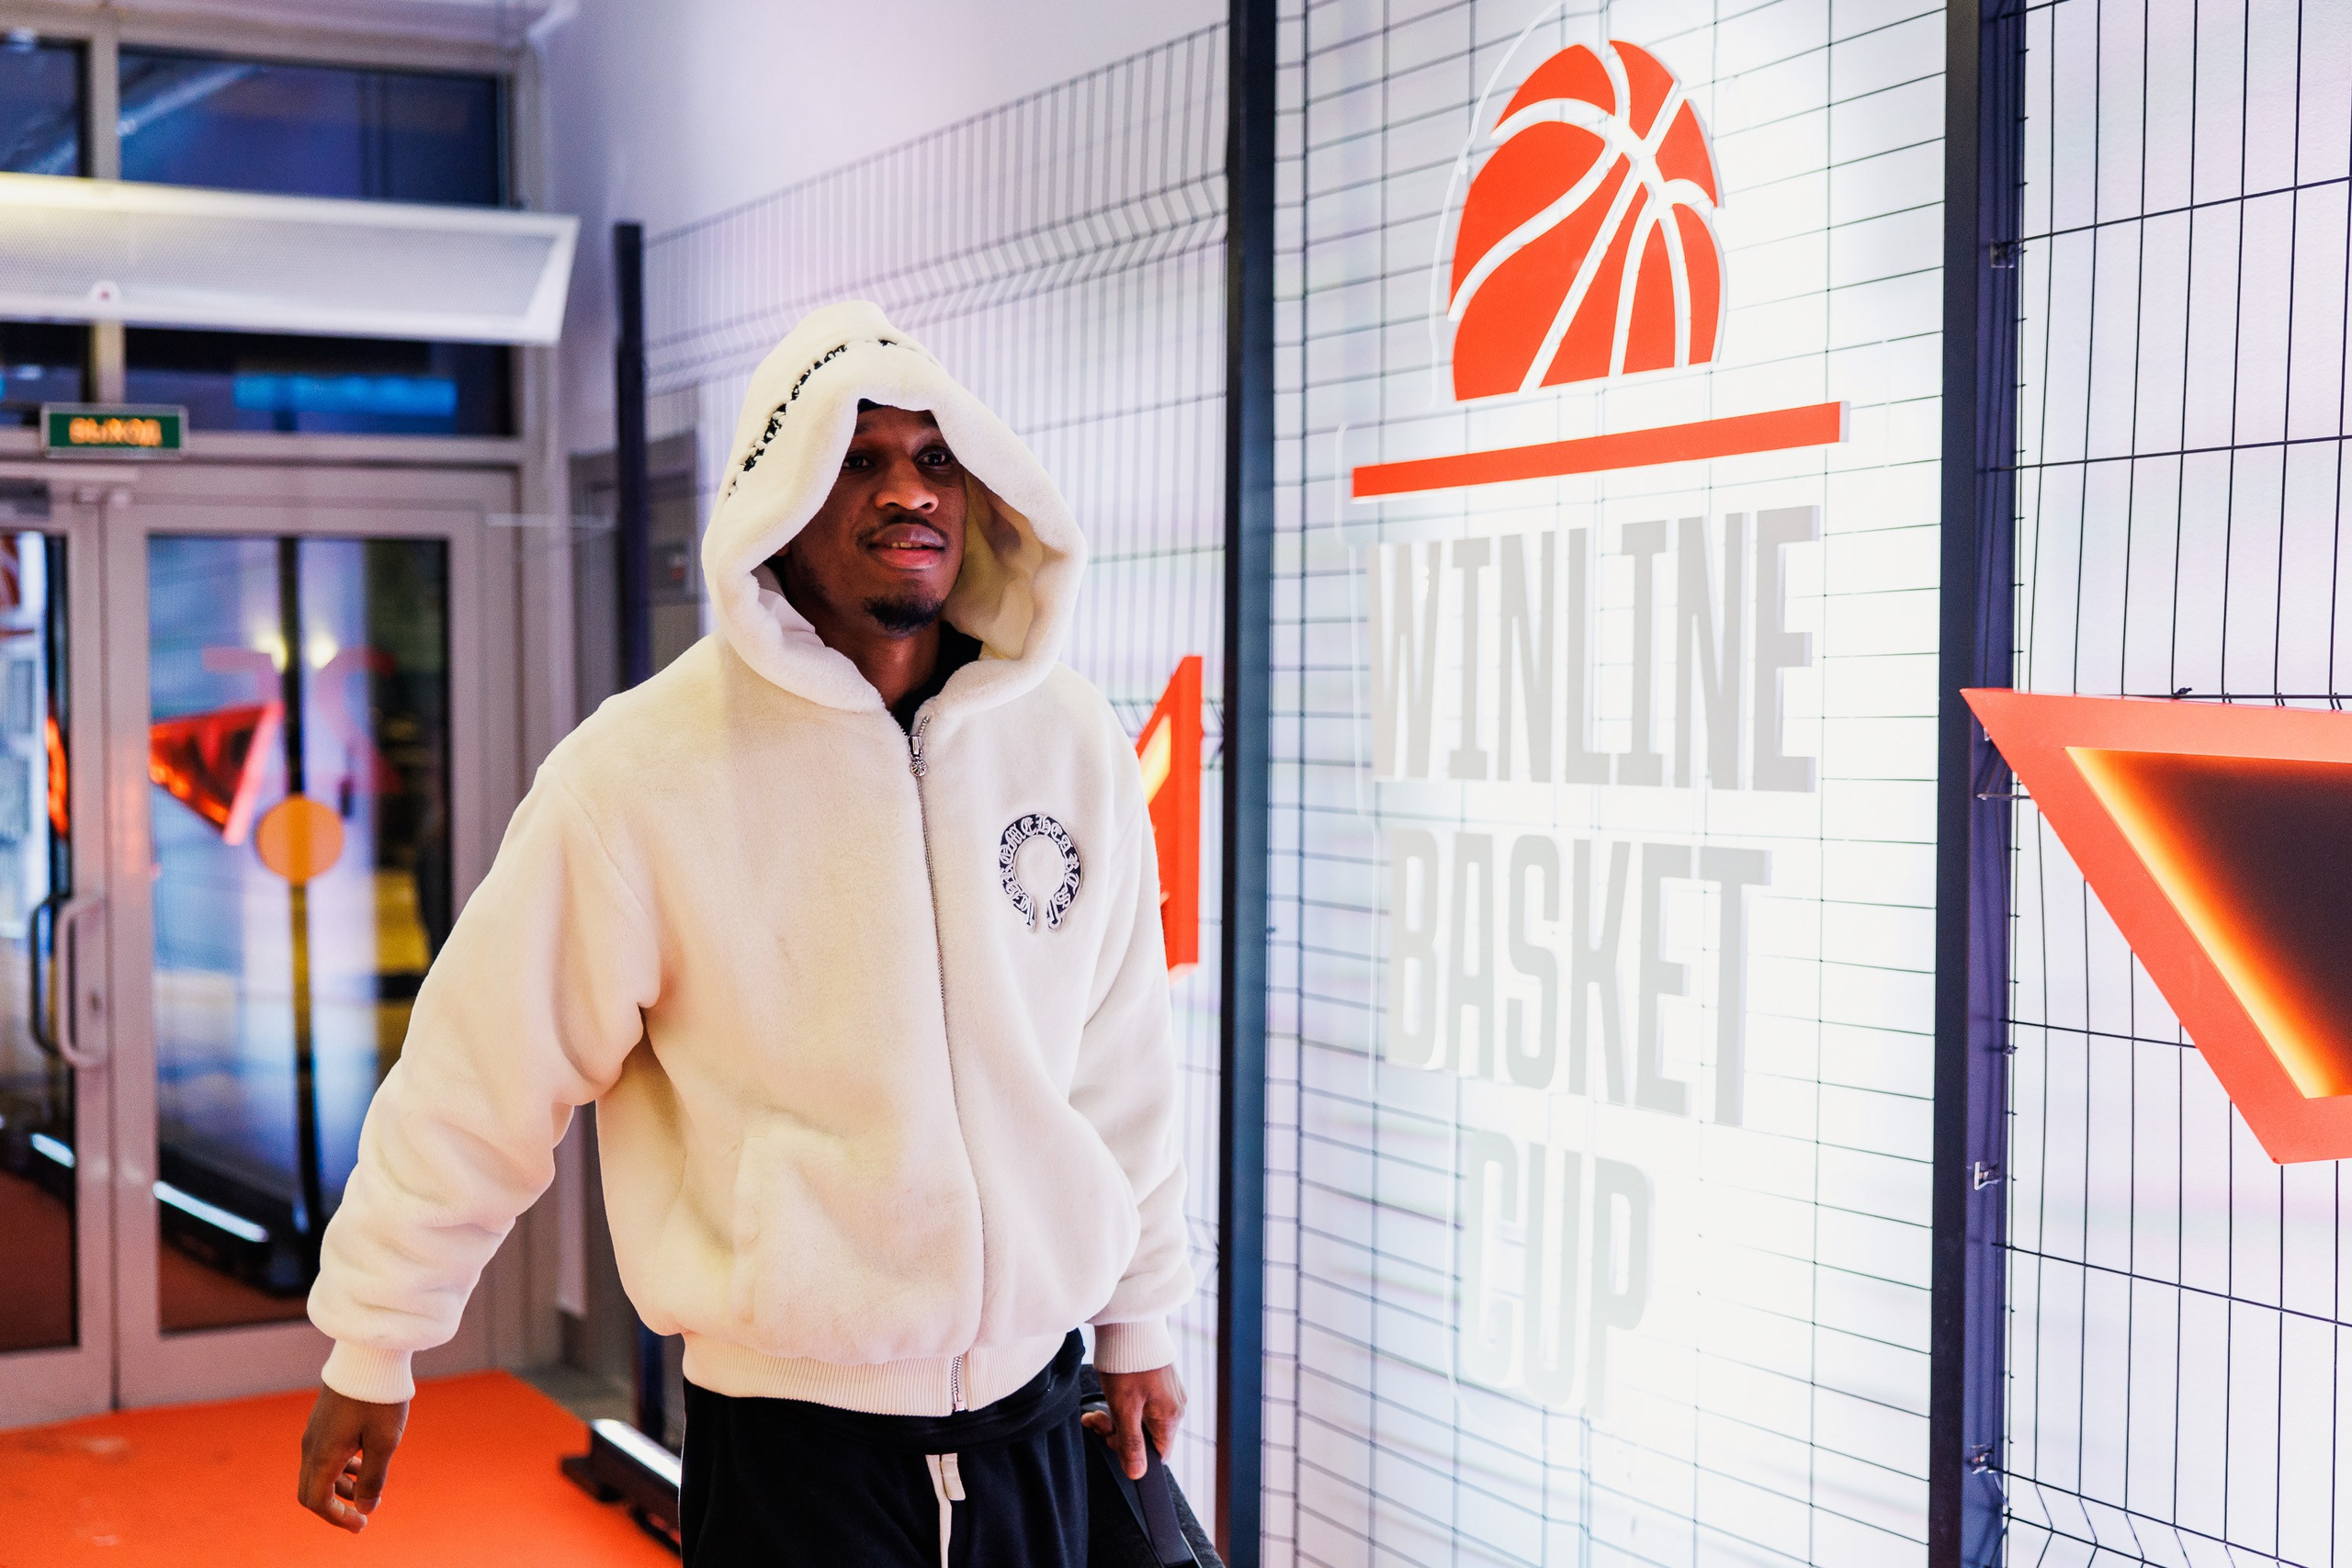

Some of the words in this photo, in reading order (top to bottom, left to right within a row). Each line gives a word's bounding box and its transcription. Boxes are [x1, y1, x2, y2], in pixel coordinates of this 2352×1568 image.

[1367, 505, 1820, 793] WINLINE
[1385, 829, 1771, 1129] BASKET
[1465, 1128, 1653, 1420] CUP
